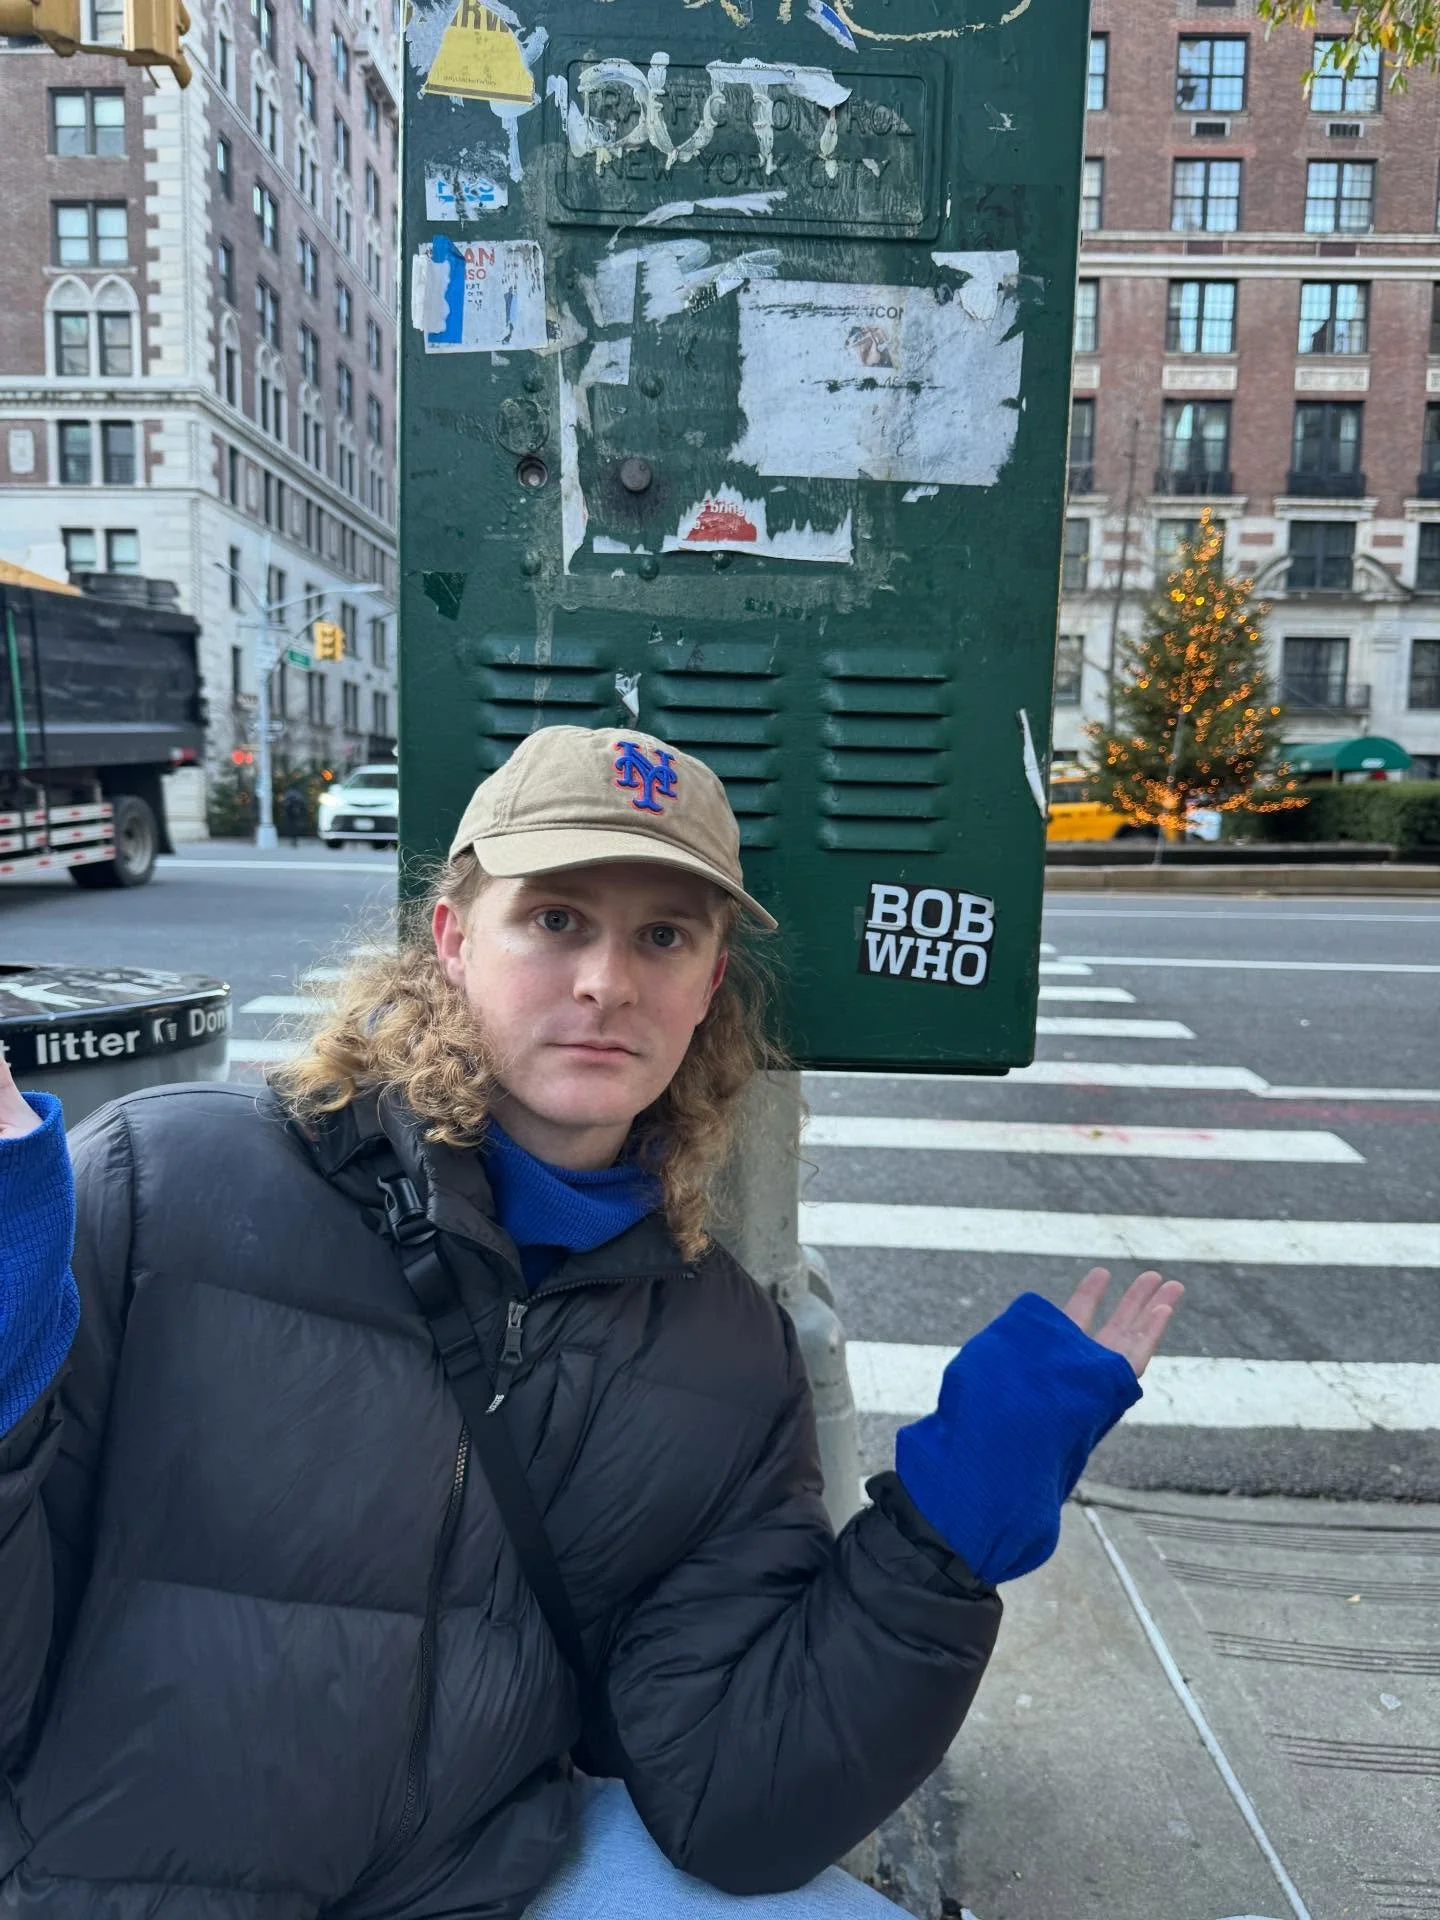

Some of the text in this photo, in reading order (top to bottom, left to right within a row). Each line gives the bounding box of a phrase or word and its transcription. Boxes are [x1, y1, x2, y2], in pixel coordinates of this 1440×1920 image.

[600, 149, 674, 182] NEW
[699, 152, 788, 187] YORK
[612, 740, 679, 815] NY
[866, 883, 996, 943] BOB
[865, 931, 988, 986] WHO
[36, 1029, 141, 1065] litter
